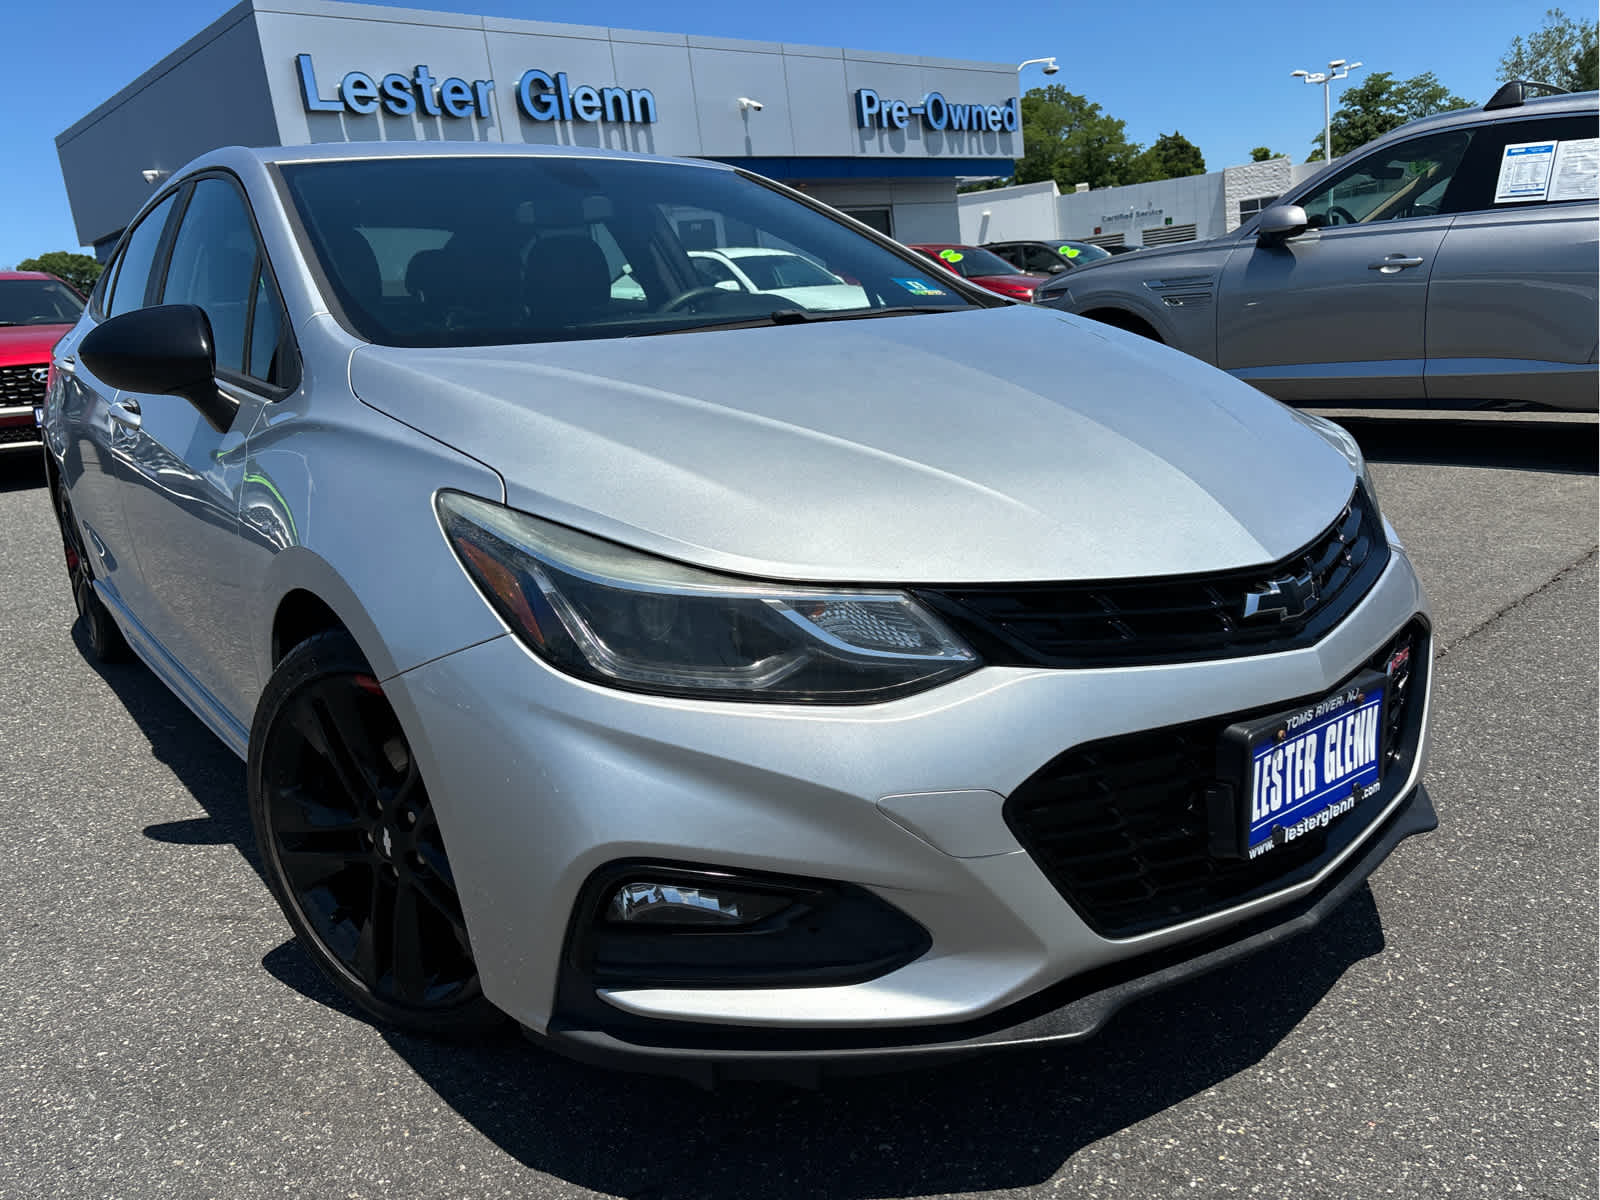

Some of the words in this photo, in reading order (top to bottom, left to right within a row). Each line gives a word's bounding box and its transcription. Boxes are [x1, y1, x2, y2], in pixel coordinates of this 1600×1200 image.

[296, 53, 494, 118] Lester
[517, 69, 657, 123] Glenn
[855, 88, 1018, 132] Pre-Owned
[1286, 709, 1314, 731] TOMS
[1346, 687, 1360, 703] NJ
[1252, 733, 1317, 823] LESTER
[1323, 704, 1379, 785] GLENN
[1283, 797, 1355, 843] lesterglenn
